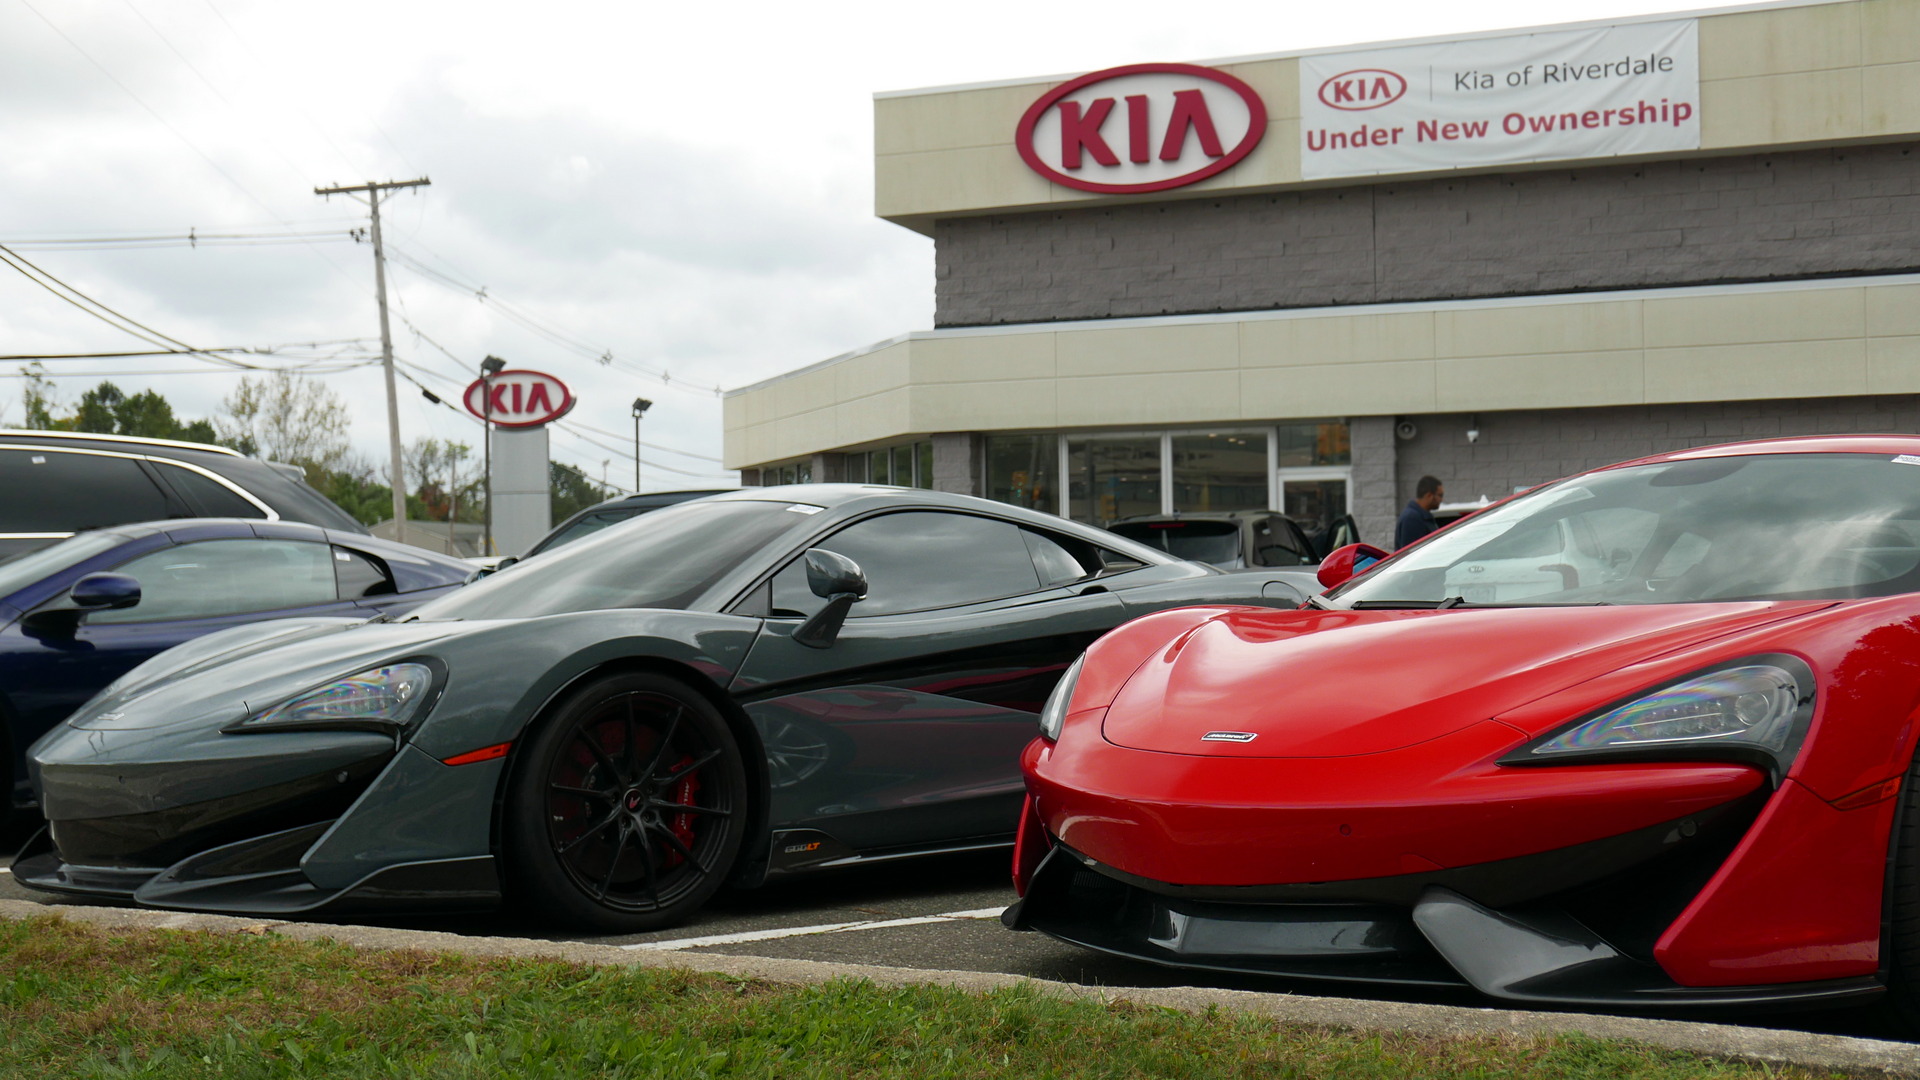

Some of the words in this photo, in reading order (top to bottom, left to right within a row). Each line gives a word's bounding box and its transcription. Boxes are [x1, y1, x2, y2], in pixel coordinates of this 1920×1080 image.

[1333, 76, 1393, 103] KIA
[1455, 71, 1494, 91] Kia
[1506, 66, 1533, 87] of
[1543, 53, 1674, 84] Riverdale
[1056, 89, 1224, 169] KIA
[1308, 124, 1403, 152] Under
[1417, 119, 1489, 143] New
[1503, 98, 1692, 135] Ownership
[482, 382, 553, 414] KIA
